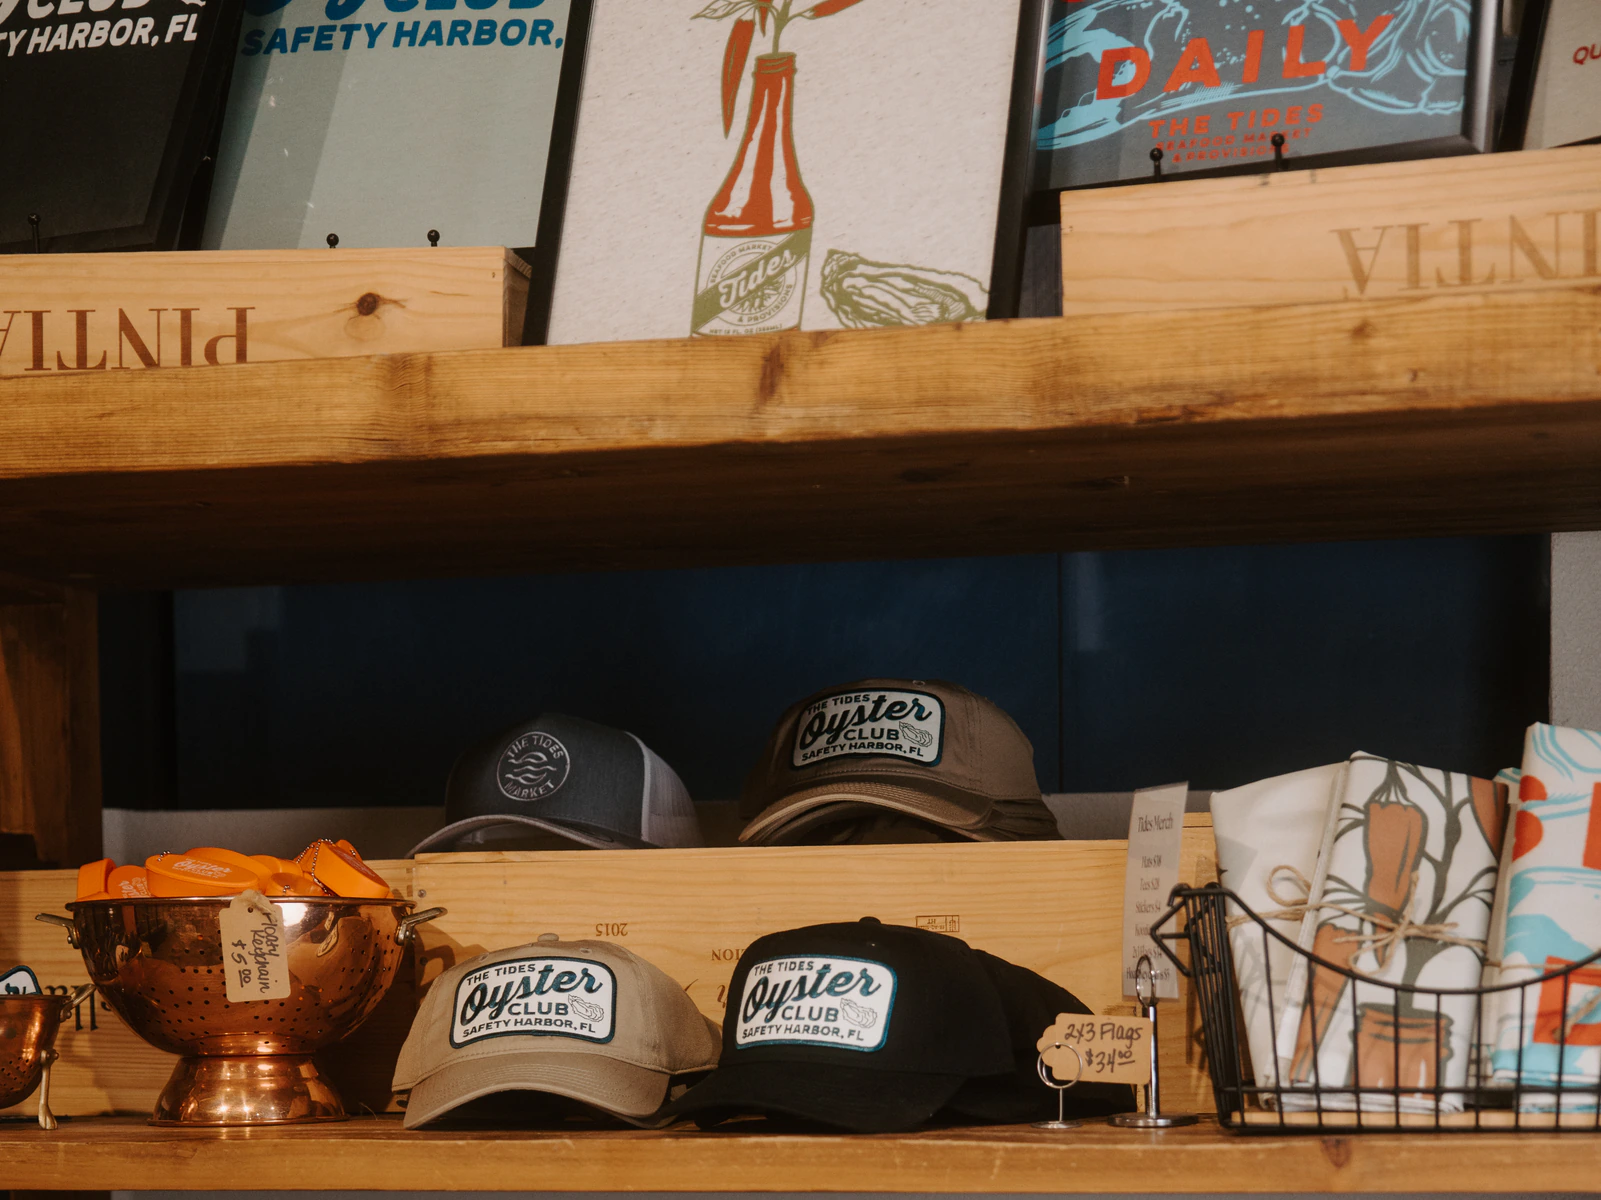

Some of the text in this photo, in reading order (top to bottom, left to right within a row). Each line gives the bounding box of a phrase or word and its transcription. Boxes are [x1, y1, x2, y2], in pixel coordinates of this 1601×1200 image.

[27, 17, 158, 55] HARBOR,
[243, 18, 564, 56] SAFETY HARBOR,
[1096, 14, 1395, 100] DAILY
[1148, 103, 1324, 139] THE TIDES
[718, 249, 796, 308] Tides
[807, 693, 870, 715] THE TIDES
[799, 695, 932, 750] Oyster
[843, 728, 900, 741] CLUB
[507, 735, 564, 759] THE TIDES
[802, 741, 924, 761] SAFETY HARBOR, FL
[504, 780, 554, 797] MARKET
[595, 922, 629, 937] 2015
[467, 963, 536, 986] THE TIDES
[754, 961, 815, 977] THE TIDES
[460, 964, 603, 1026] Oyster
[742, 963, 881, 1024] Oyster
[508, 1001, 569, 1016] CLUB
[781, 1005, 839, 1023] CLUB
[462, 1017, 596, 1038] SAFETY HARBOR, FL
[742, 1024, 864, 1041] SAFETY HARBOR, FL
[1100, 1022, 1143, 1050] Flags
